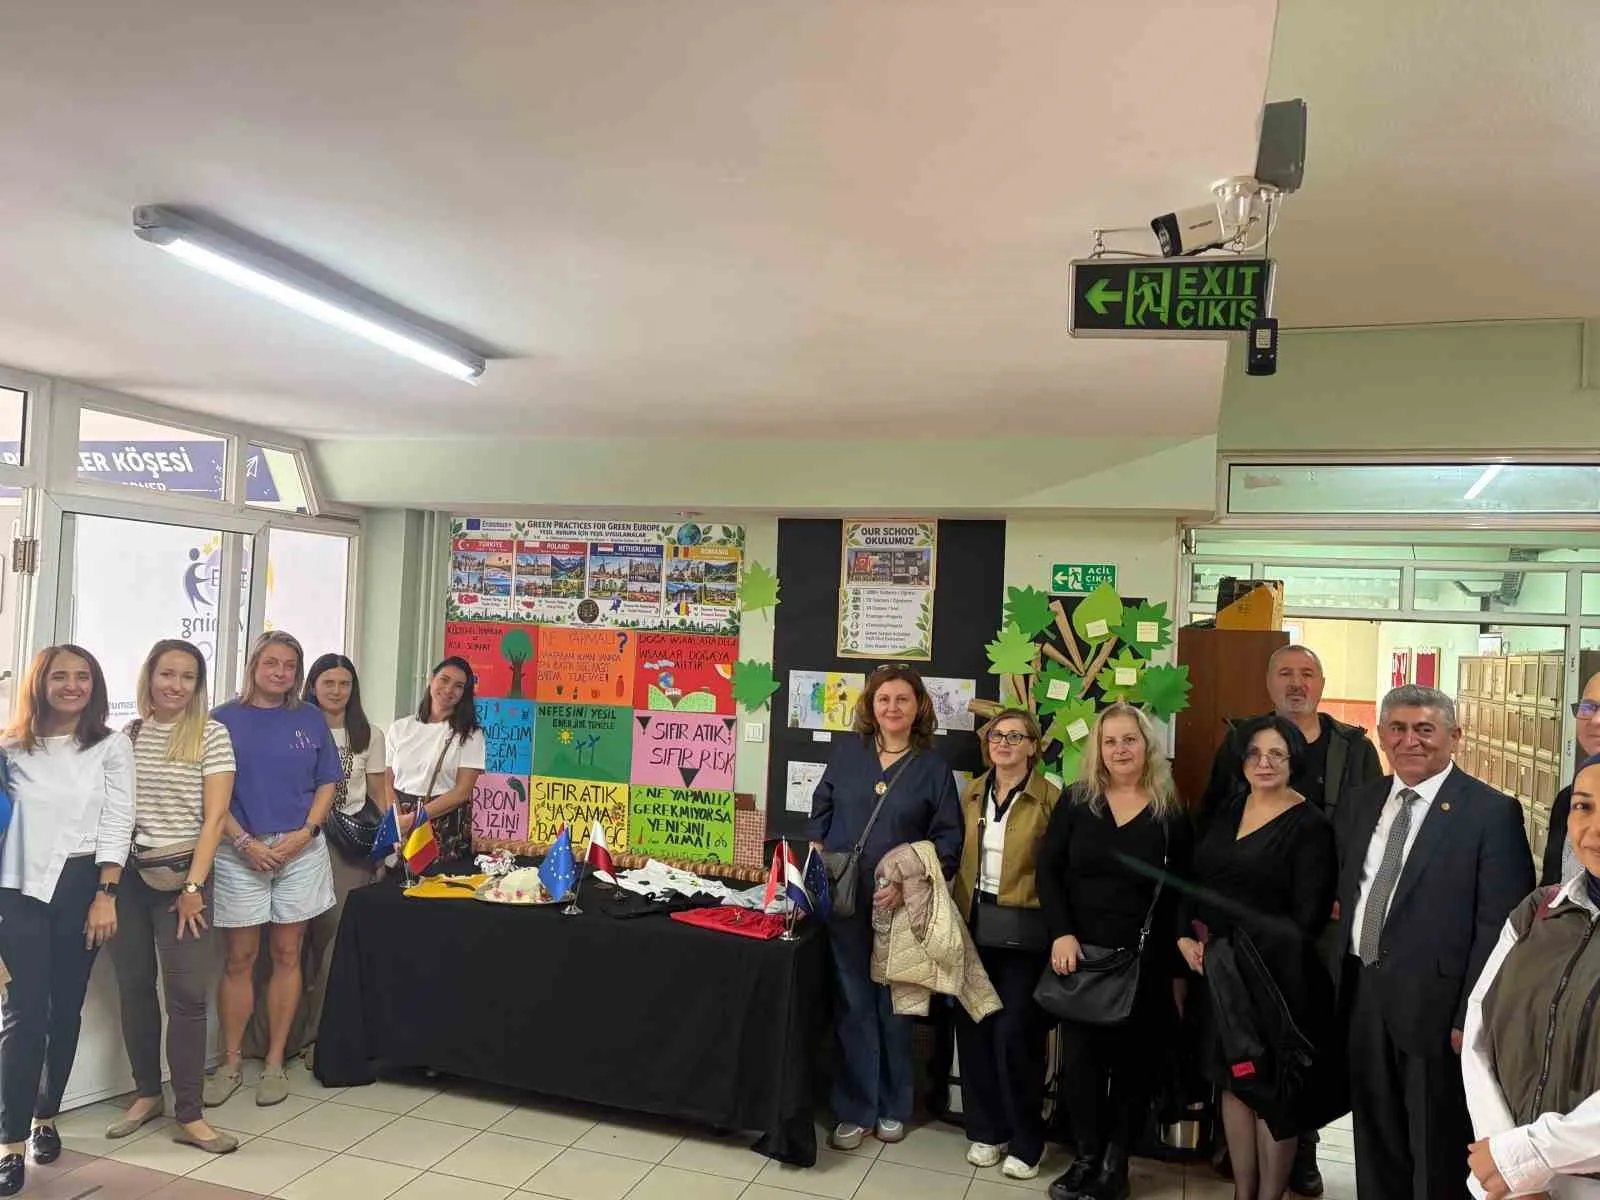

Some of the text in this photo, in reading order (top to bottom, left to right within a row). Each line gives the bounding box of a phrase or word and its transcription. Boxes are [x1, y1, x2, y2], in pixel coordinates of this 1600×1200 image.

[1179, 266, 1260, 295] EXIT
[112, 446, 193, 479] KÖŞESİ
[527, 520, 552, 529] GREEN
[554, 521, 591, 530] PRACTICES
[608, 523, 631, 531] GREEN
[633, 524, 660, 532] EUROPE
[861, 527, 920, 536] OUR SCHOOL
[618, 545, 657, 553] NETHERLANDS
[864, 536, 915, 545] OKULUMUZ
[652, 722, 689, 740] SIFIR
[650, 747, 735, 776] SIFIR RİSK
[472, 786, 516, 811] RBON
[536, 782, 618, 804] SIFIR ATIK
[646, 787, 666, 799] NE
